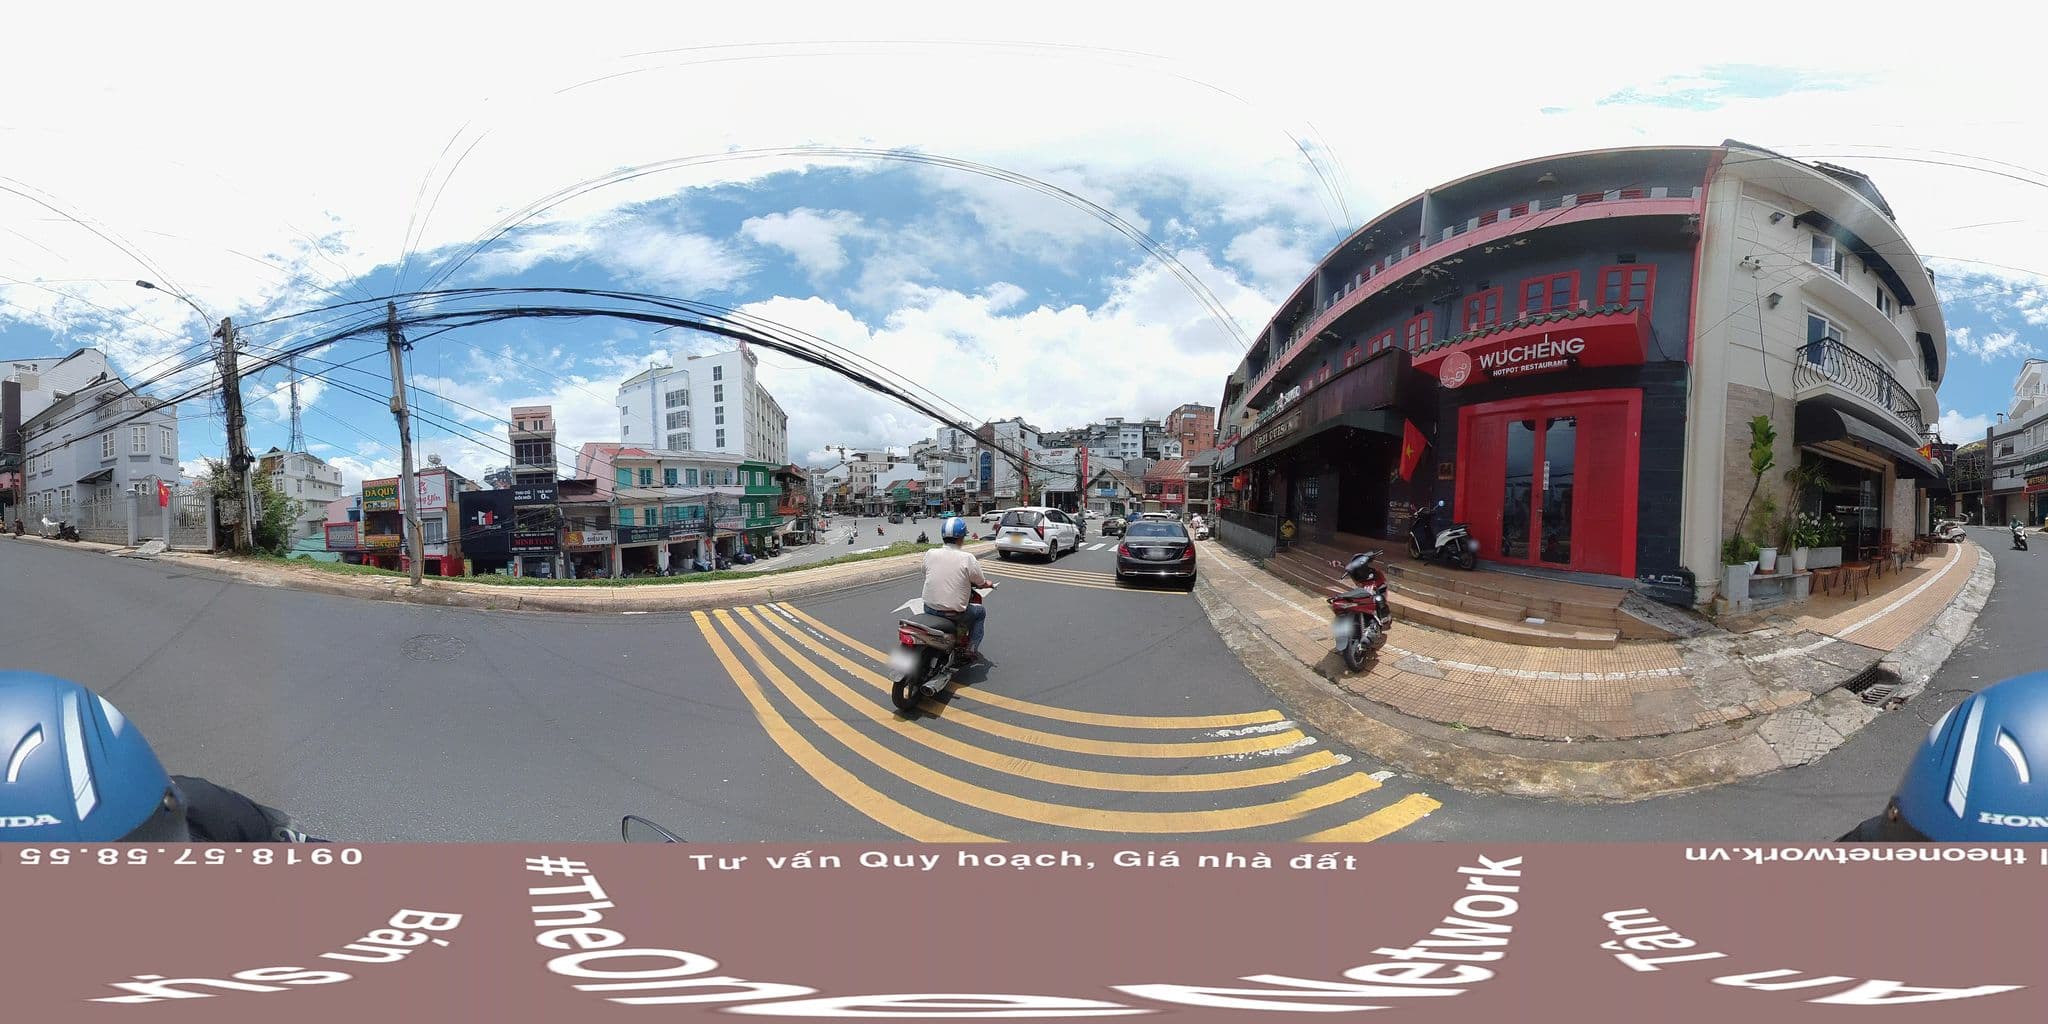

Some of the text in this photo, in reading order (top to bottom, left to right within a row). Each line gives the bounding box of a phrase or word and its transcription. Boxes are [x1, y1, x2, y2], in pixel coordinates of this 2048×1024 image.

[1478, 338, 1586, 370] WUCHENG
[1492, 359, 1569, 377] HOTPOT RESTAURANT
[0, 814, 63, 828] DA
